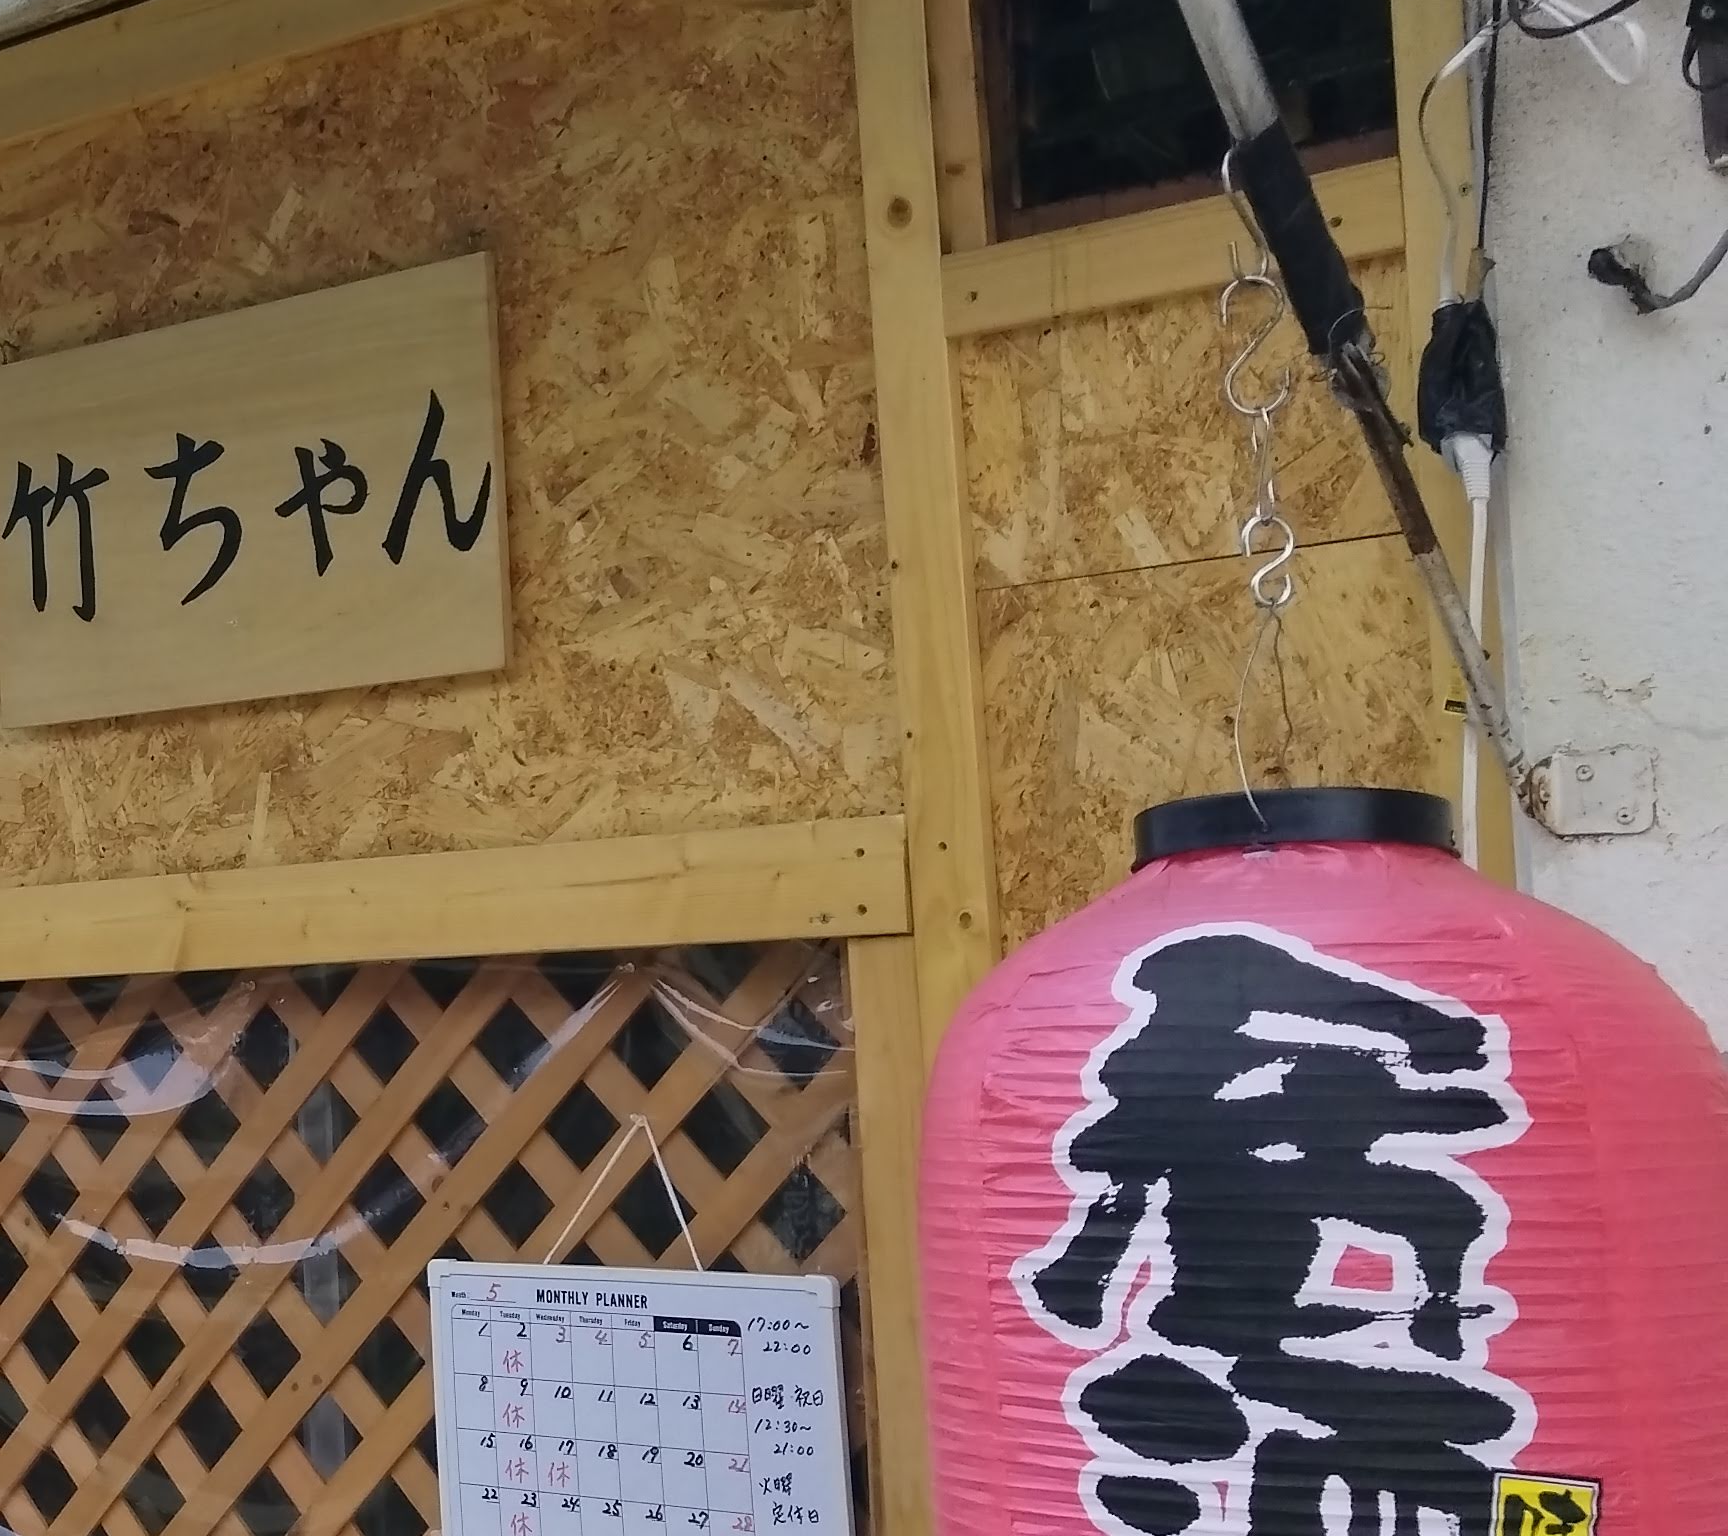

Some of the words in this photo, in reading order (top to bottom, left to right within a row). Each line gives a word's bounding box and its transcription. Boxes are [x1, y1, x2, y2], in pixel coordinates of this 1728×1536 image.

[1, 388, 491, 622] 竹ちゃん
[486, 1282, 502, 1302] 5
[536, 1288, 589, 1306] MONTHLY
[596, 1292, 648, 1309] PLANNER
[499, 1310, 521, 1320] Tuesday
[578, 1315, 603, 1326] Thursday
[624, 1318, 641, 1328] Friday
[516, 1322, 527, 1338] 2
[556, 1326, 566, 1344] 3
[594, 1329, 608, 1346] 4
[638, 1331, 652, 1349] 5
[682, 1334, 694, 1352] 6
[727, 1338, 740, 1357] 7
[762, 1340, 813, 1356] 22:00
[502, 1349, 524, 1374] 休
[478, 1375, 489, 1392] 8
[519, 1378, 529, 1397] 9
[554, 1385, 572, 1399] 10
[597, 1389, 614, 1403] 11
[639, 1392, 656, 1406] 12
[682, 1394, 702, 1410] 13
[502, 1402, 526, 1429] 休
[480, 1432, 496, 1449] 15
[519, 1435, 534, 1450] 16
[558, 1439, 575, 1456] 17
[598, 1443, 618, 1460] 18
[641, 1446, 660, 1464] 19
[773, 1442, 815, 1457] 21:00
[683, 1451, 704, 1467] 20
[728, 1458, 749, 1473] 21
[505, 1457, 530, 1484] 休
[547, 1461, 571, 1488] 休
[481, 1487, 499, 1500] 22
[520, 1492, 537, 1508] 23
[561, 1496, 581, 1513] 24
[602, 1499, 623, 1517] 25
[645, 1504, 663, 1521] 26
[687, 1511, 710, 1530] 27
[772, 1501, 821, 1527] 定休日
[732, 1515, 753, 1532] 28
